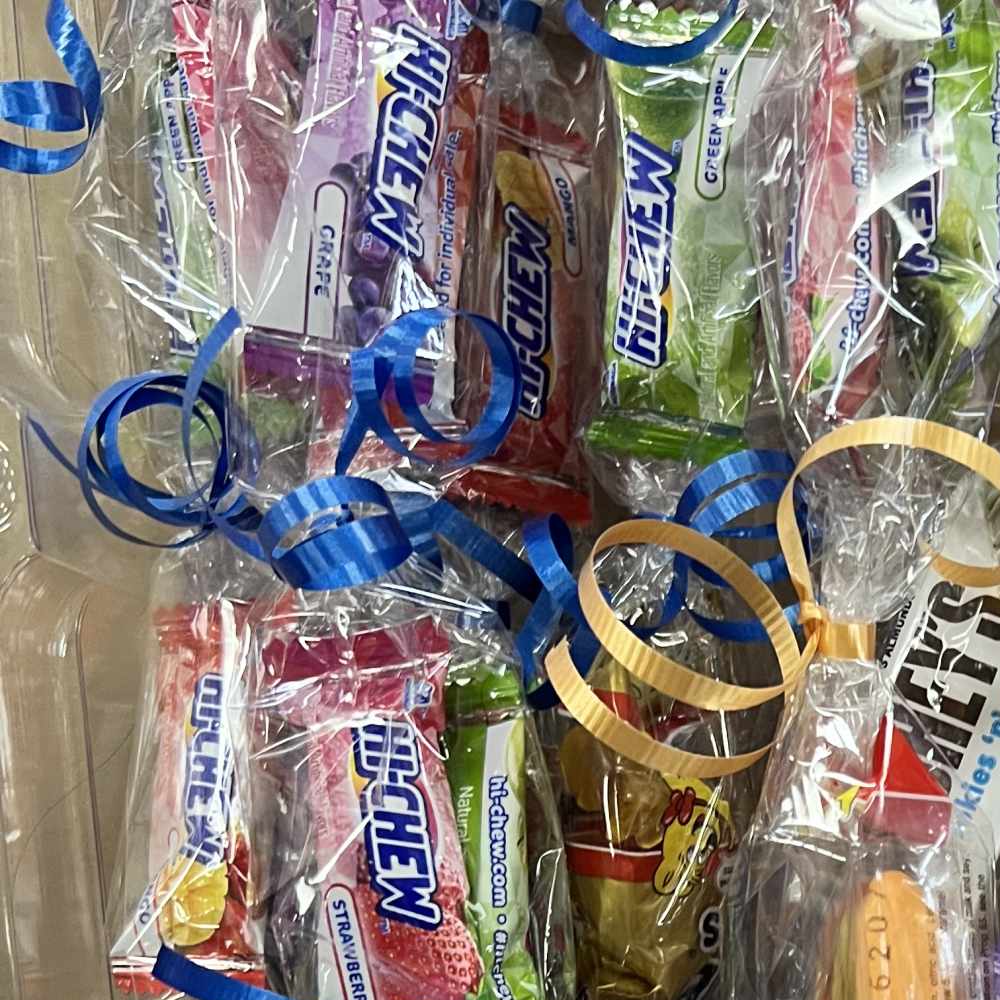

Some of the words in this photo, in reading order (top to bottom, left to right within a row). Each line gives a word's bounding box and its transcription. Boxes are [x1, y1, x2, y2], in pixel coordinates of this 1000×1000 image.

[369, 22, 453, 258] HI-CHEW
[704, 122, 724, 183] GREEN
[313, 224, 335, 297] GRAPE
[439, 170, 457, 264] individual
[554, 177, 578, 249] MANGO
[613, 132, 677, 368] HI-CHEW
[437, 266, 455, 289] for
[502, 203, 553, 420] HI-CHEW
[352, 716, 442, 930] HI-CHEW
[488, 774, 509, 909] hi-chew.com
